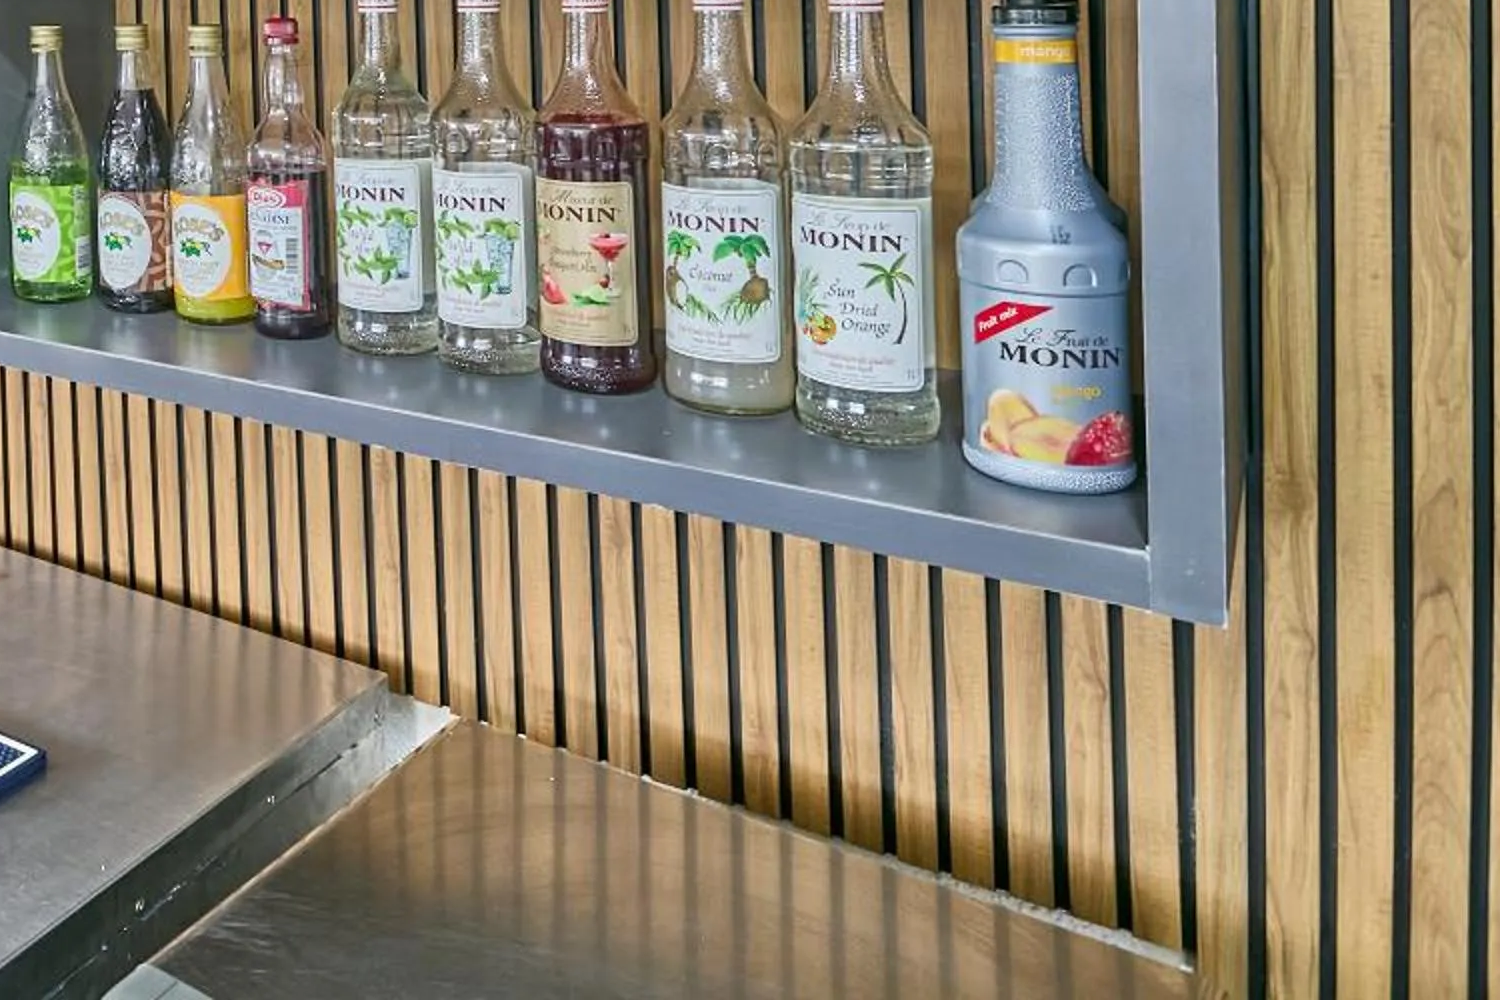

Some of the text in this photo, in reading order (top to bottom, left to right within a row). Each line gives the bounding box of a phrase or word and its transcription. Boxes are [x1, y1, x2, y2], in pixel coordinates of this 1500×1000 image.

[667, 211, 759, 233] MONIN
[800, 226, 902, 253] MONIN
[825, 278, 856, 300] Sun
[840, 302, 879, 317] Dried
[978, 306, 1019, 334] Fruit mix
[841, 318, 892, 340] Orange
[1015, 326, 1109, 347] Le Fruit de
[998, 341, 1120, 370] MONIN
